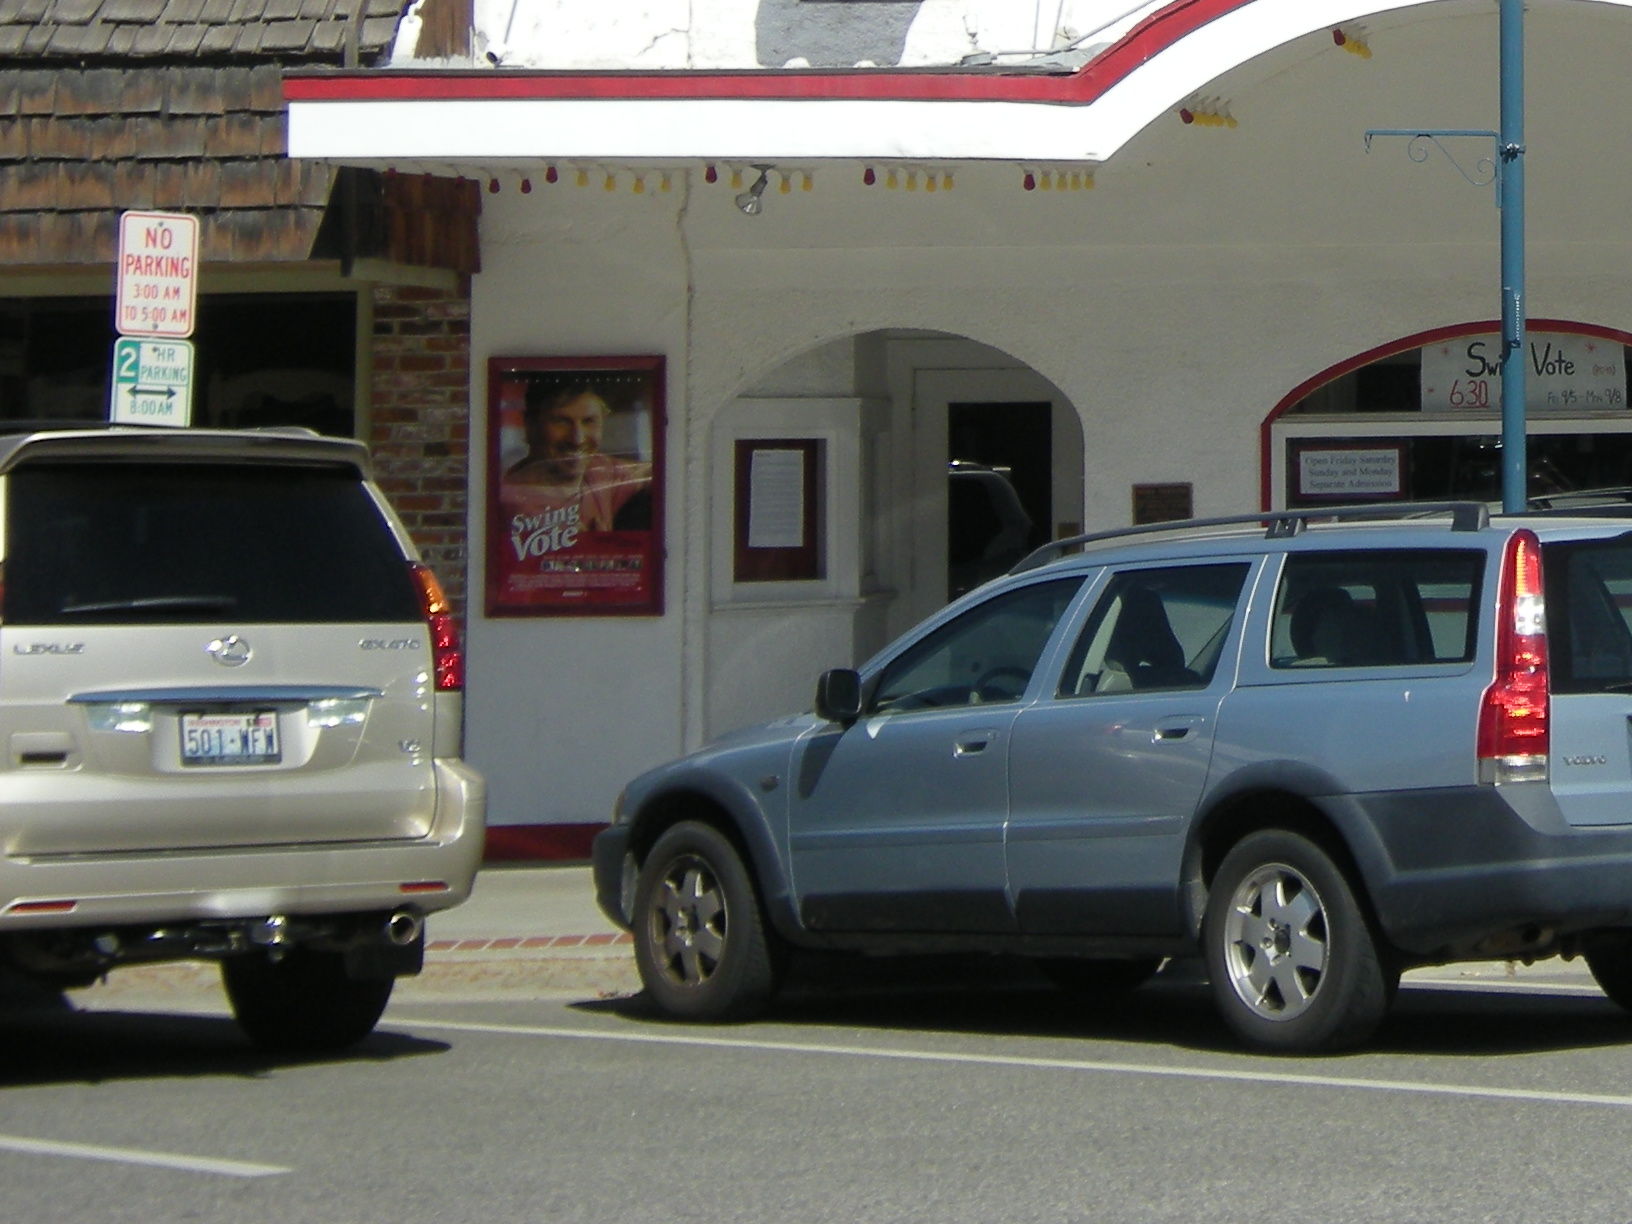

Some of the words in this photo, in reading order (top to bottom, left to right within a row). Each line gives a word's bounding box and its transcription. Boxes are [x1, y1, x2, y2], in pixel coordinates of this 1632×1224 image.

[145, 228, 173, 249] NO
[125, 254, 190, 279] PARKING
[133, 284, 159, 299] 3:00
[163, 285, 181, 299] AM
[124, 305, 137, 321] TO
[141, 306, 166, 322] 5:00
[171, 308, 188, 323] AM
[120, 347, 137, 376] 2
[157, 348, 175, 362] HR
[1530, 342, 1576, 376] Vote
[141, 366, 187, 382] PARKING
[1450, 380, 1489, 406] 630
[1331, 456, 1358, 466] Friday
[1360, 455, 1396, 466] Saturday
[1310, 468, 1340, 478] Sunday
[1342, 468, 1358, 476] and
[1360, 467, 1393, 478] Monday
[512, 504, 580, 532] Swing
[511, 526, 579, 562] Vote
